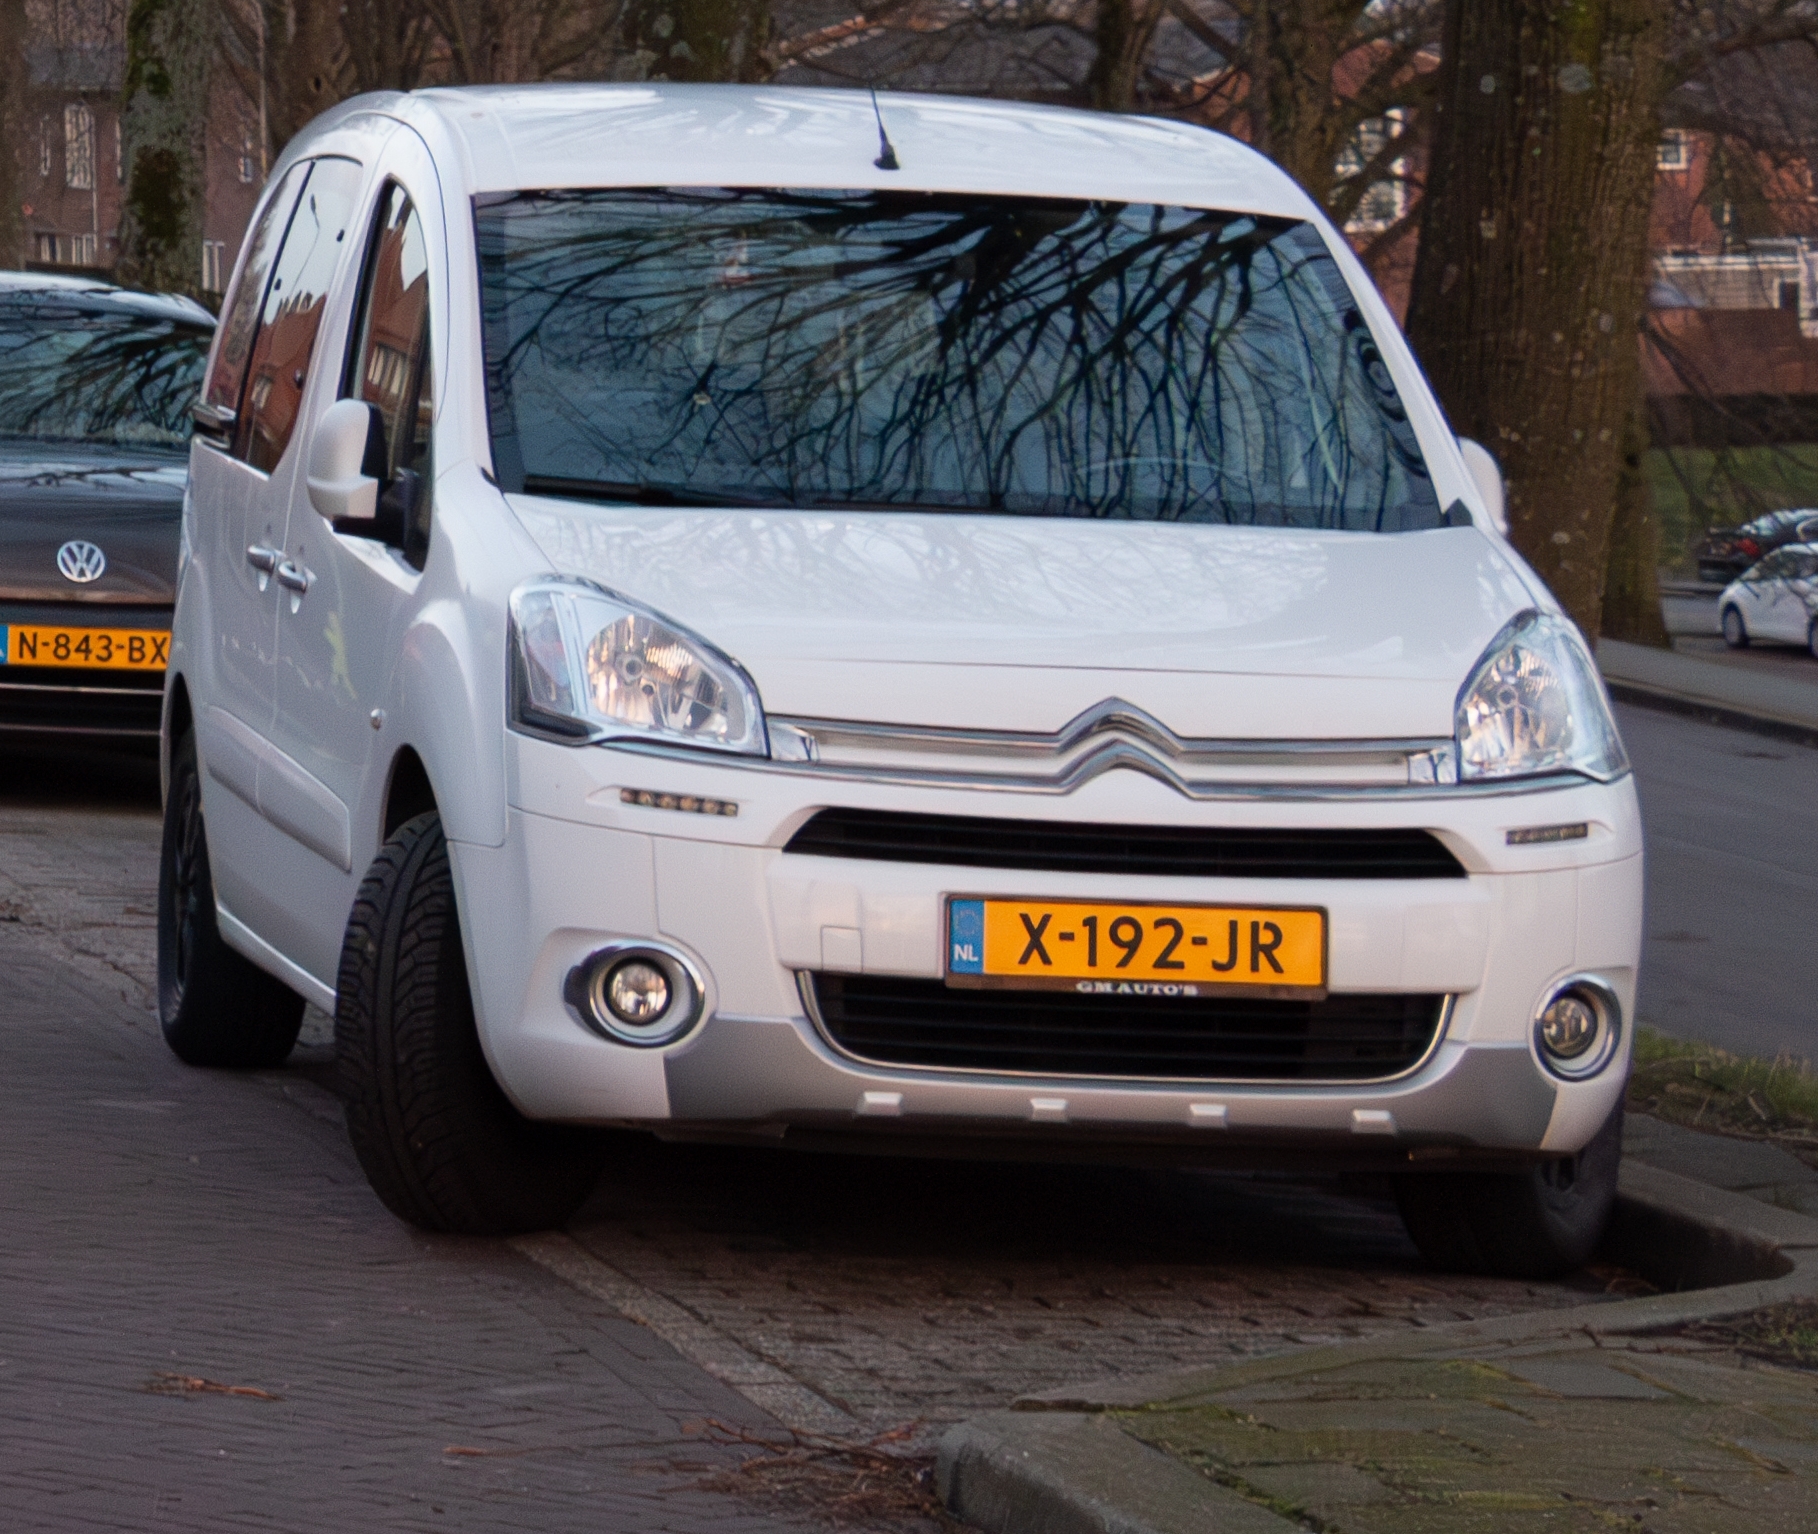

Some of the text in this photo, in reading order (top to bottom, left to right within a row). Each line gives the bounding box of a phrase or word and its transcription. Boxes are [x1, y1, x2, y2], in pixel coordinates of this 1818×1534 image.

[18, 631, 168, 664] N-843-BX
[954, 943, 979, 962] NL
[1017, 913, 1285, 974] X-192-JR
